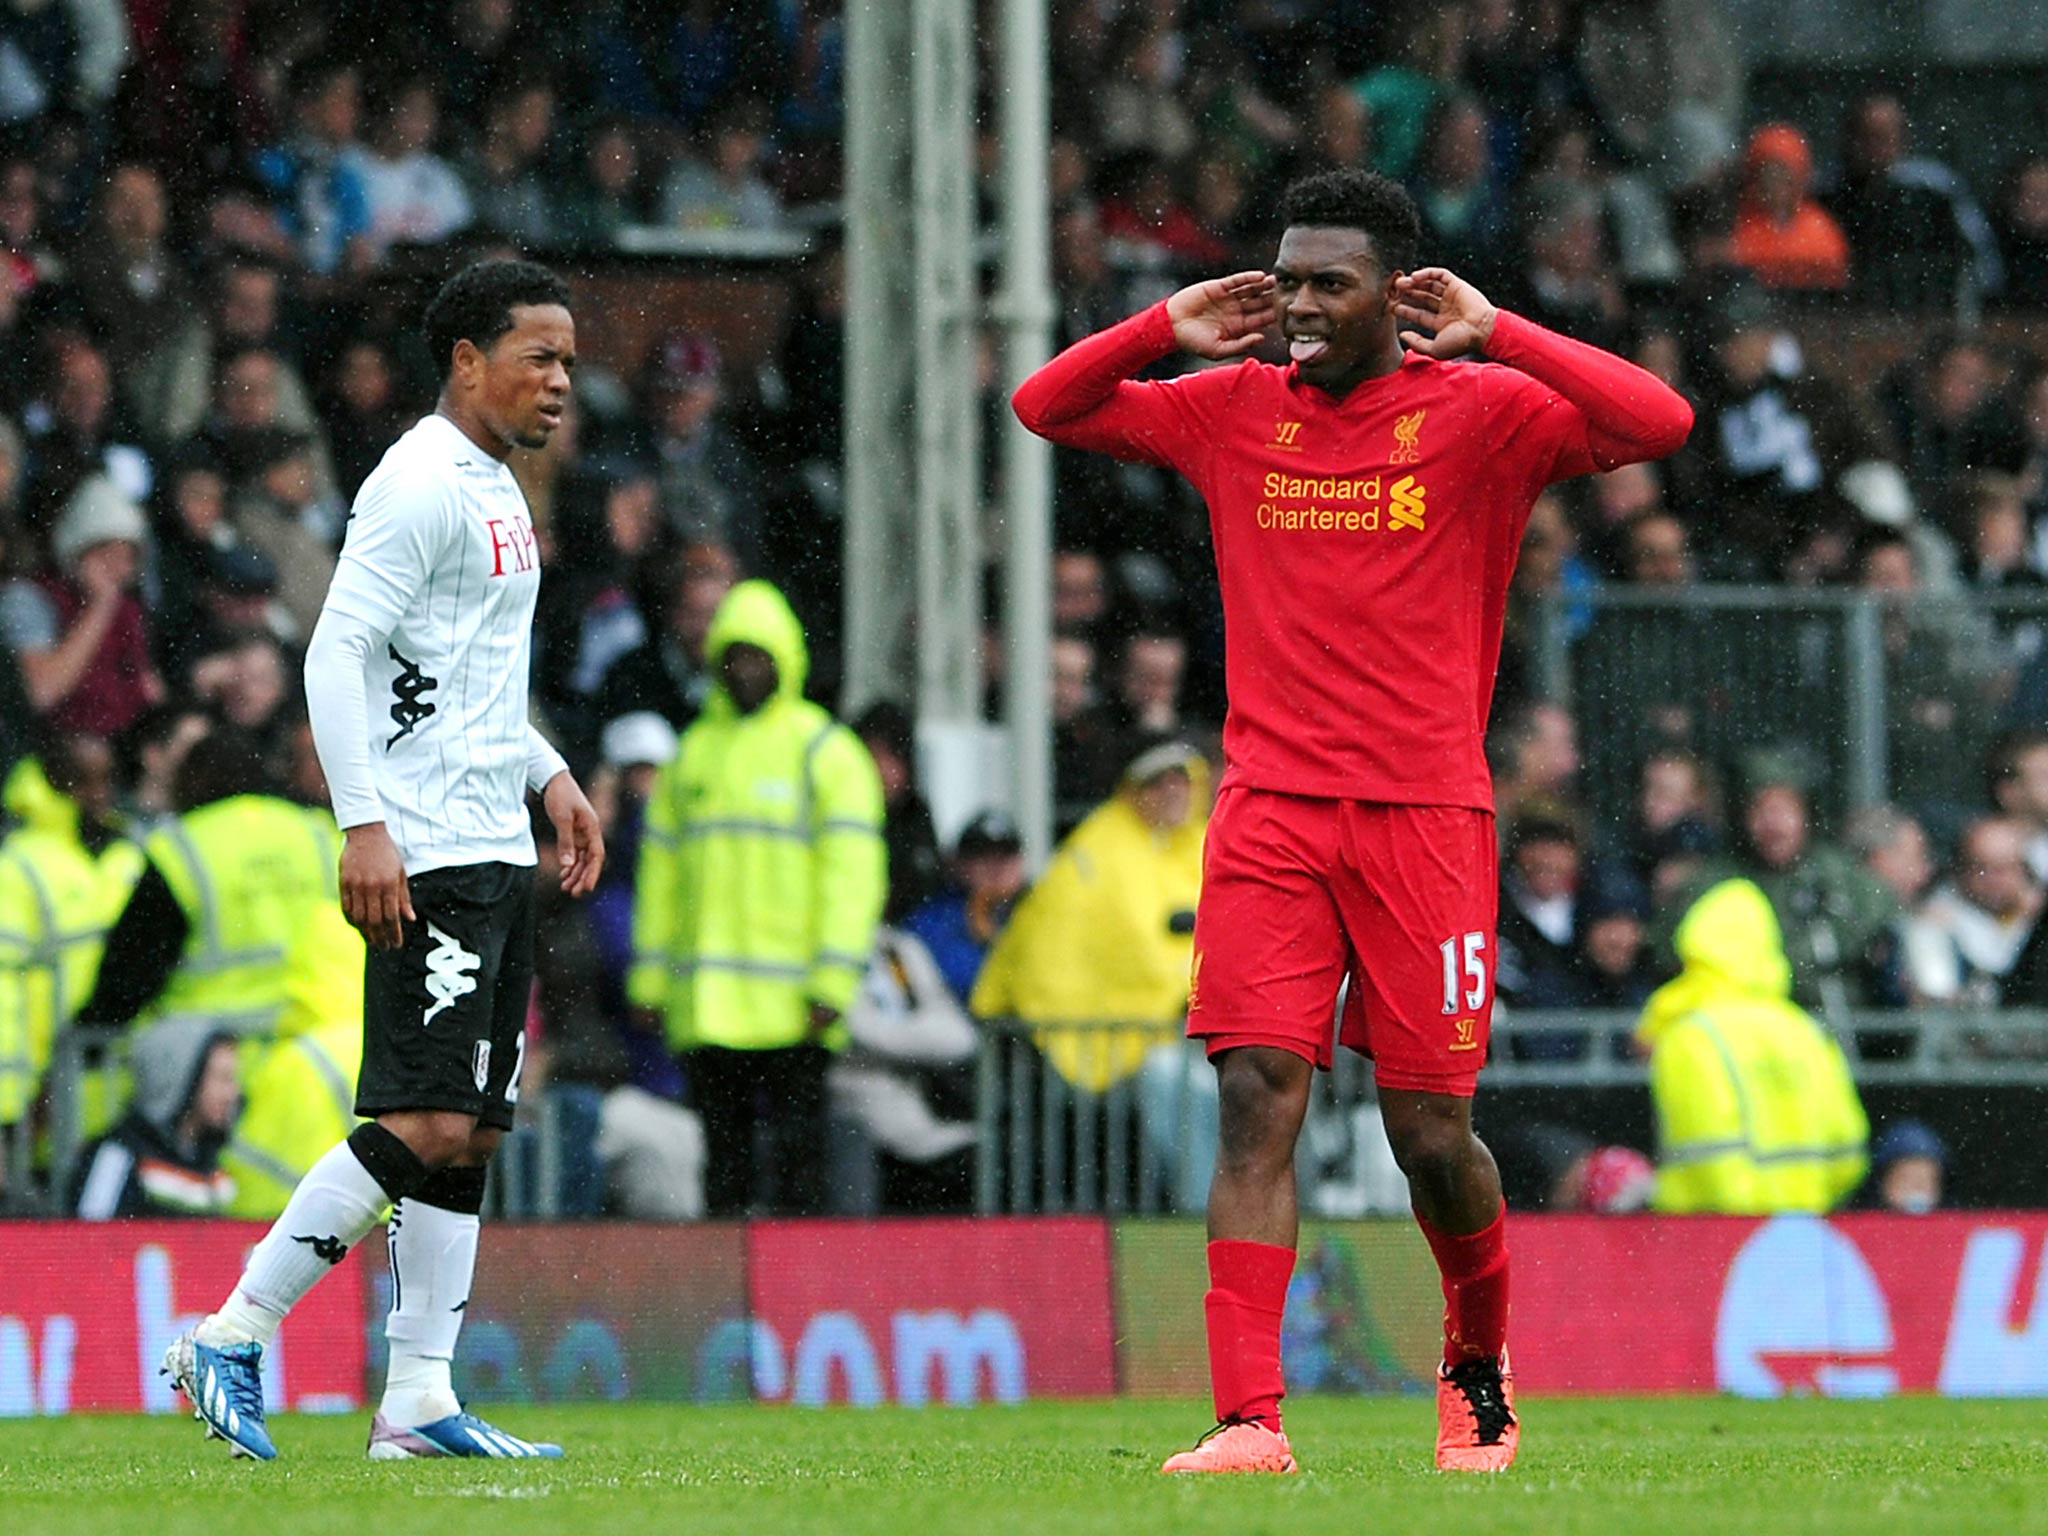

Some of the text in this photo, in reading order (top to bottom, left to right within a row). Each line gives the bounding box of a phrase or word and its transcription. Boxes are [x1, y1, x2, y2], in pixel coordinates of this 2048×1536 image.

[1263, 472, 1382, 501] Standard
[1256, 503, 1380, 532] Chartered
[1439, 931, 1486, 1015] 15
